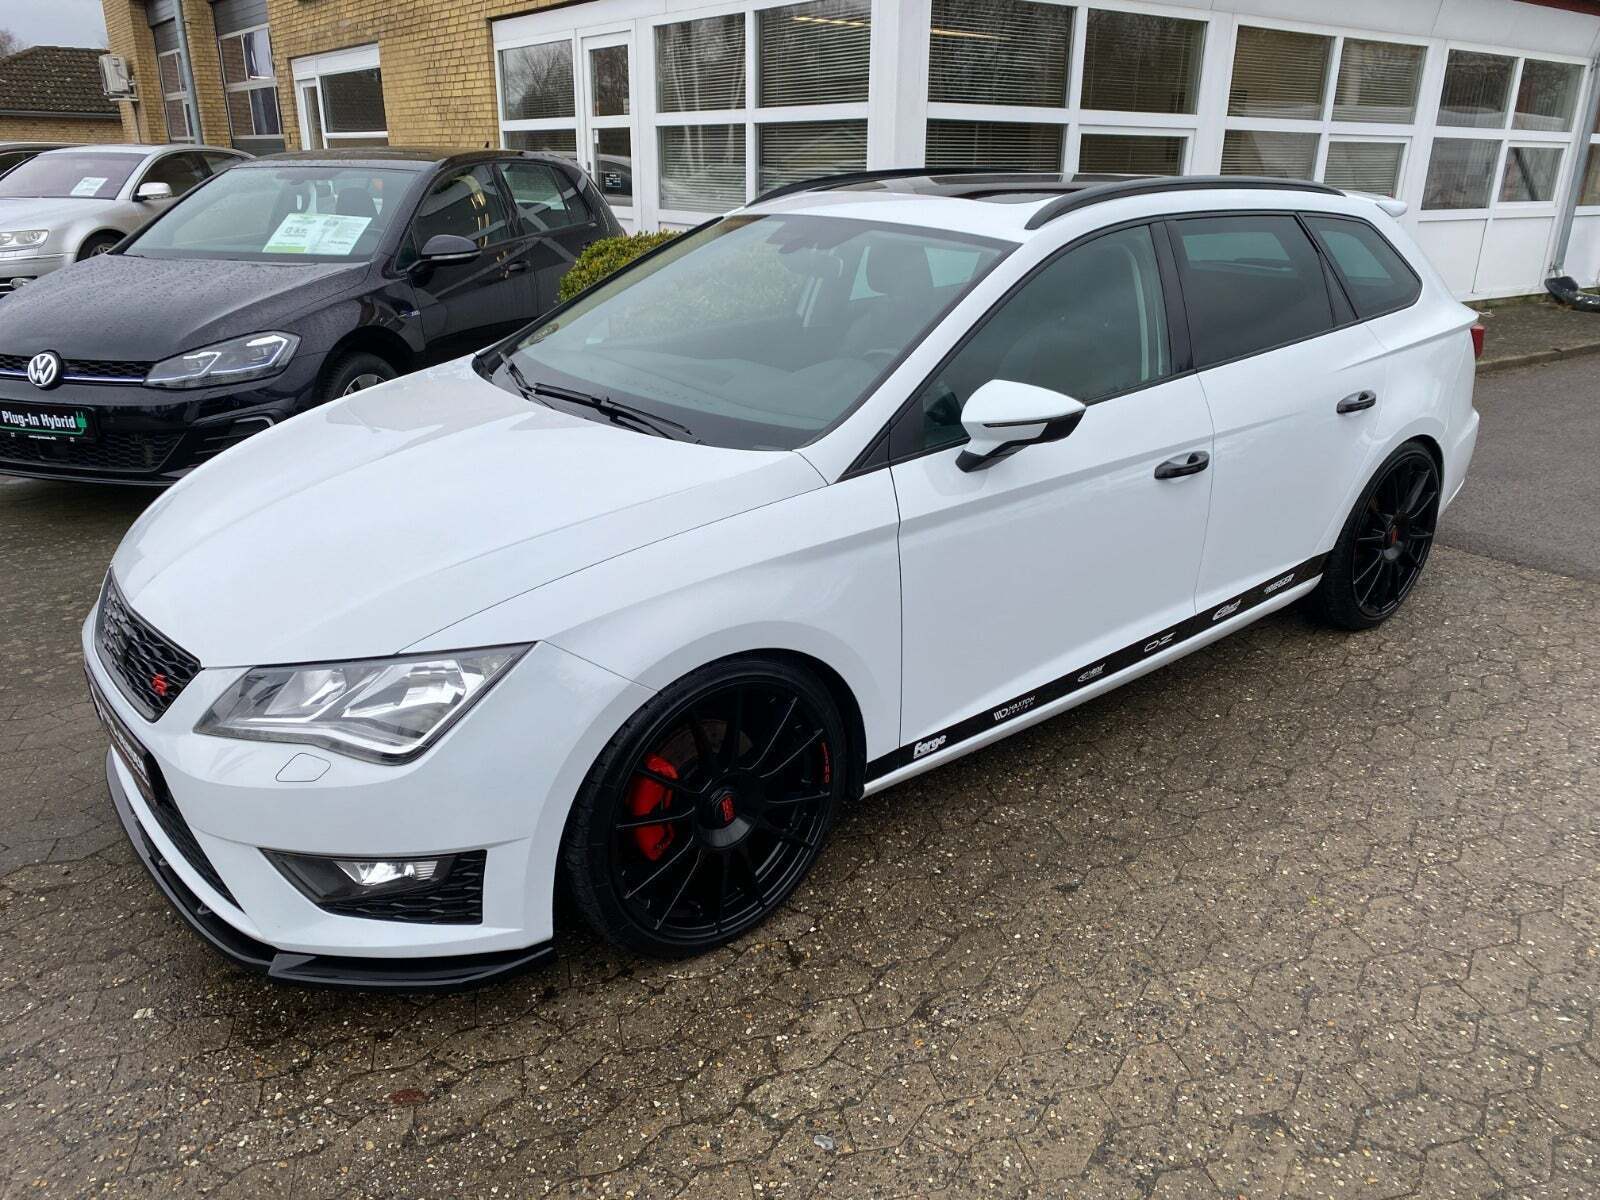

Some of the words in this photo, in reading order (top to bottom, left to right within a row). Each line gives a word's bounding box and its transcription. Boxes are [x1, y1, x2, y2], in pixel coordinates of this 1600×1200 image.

[1, 410, 40, 427] Plug-In
[40, 413, 77, 430] Hybrid
[912, 734, 947, 760] Forge
